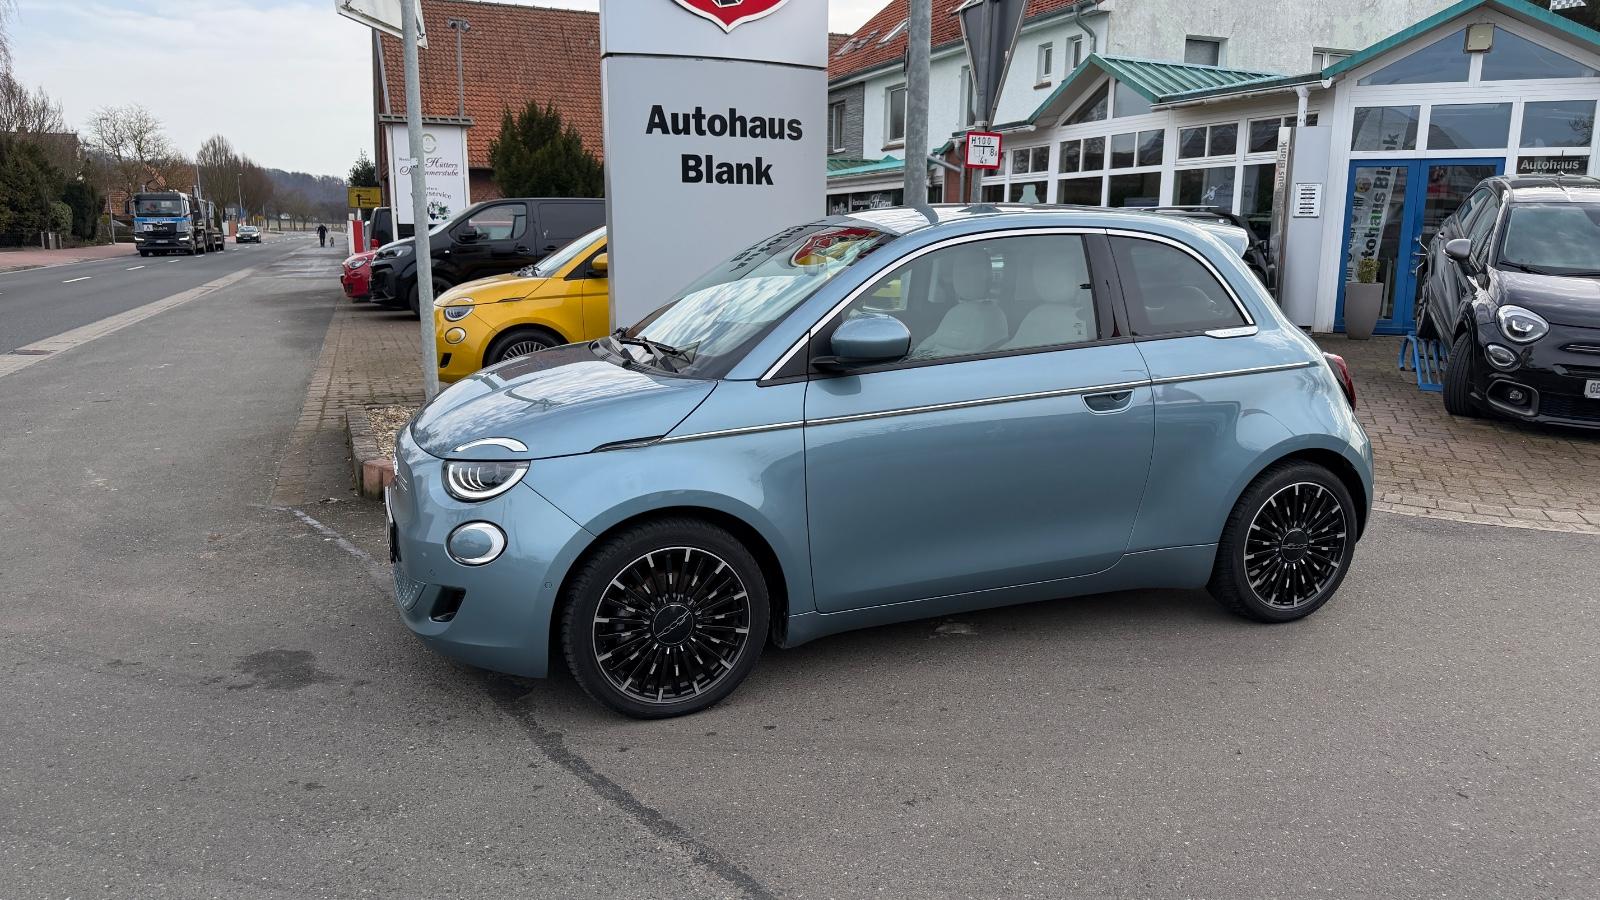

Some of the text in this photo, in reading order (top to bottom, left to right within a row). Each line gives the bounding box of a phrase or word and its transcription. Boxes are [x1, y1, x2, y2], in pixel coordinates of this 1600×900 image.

[645, 104, 803, 141] Autohaus
[681, 153, 774, 185] Blank
[1278, 141, 1288, 169] Blank
[1520, 160, 1580, 170] Autohaus
[1361, 192, 1387, 259] tohaus
